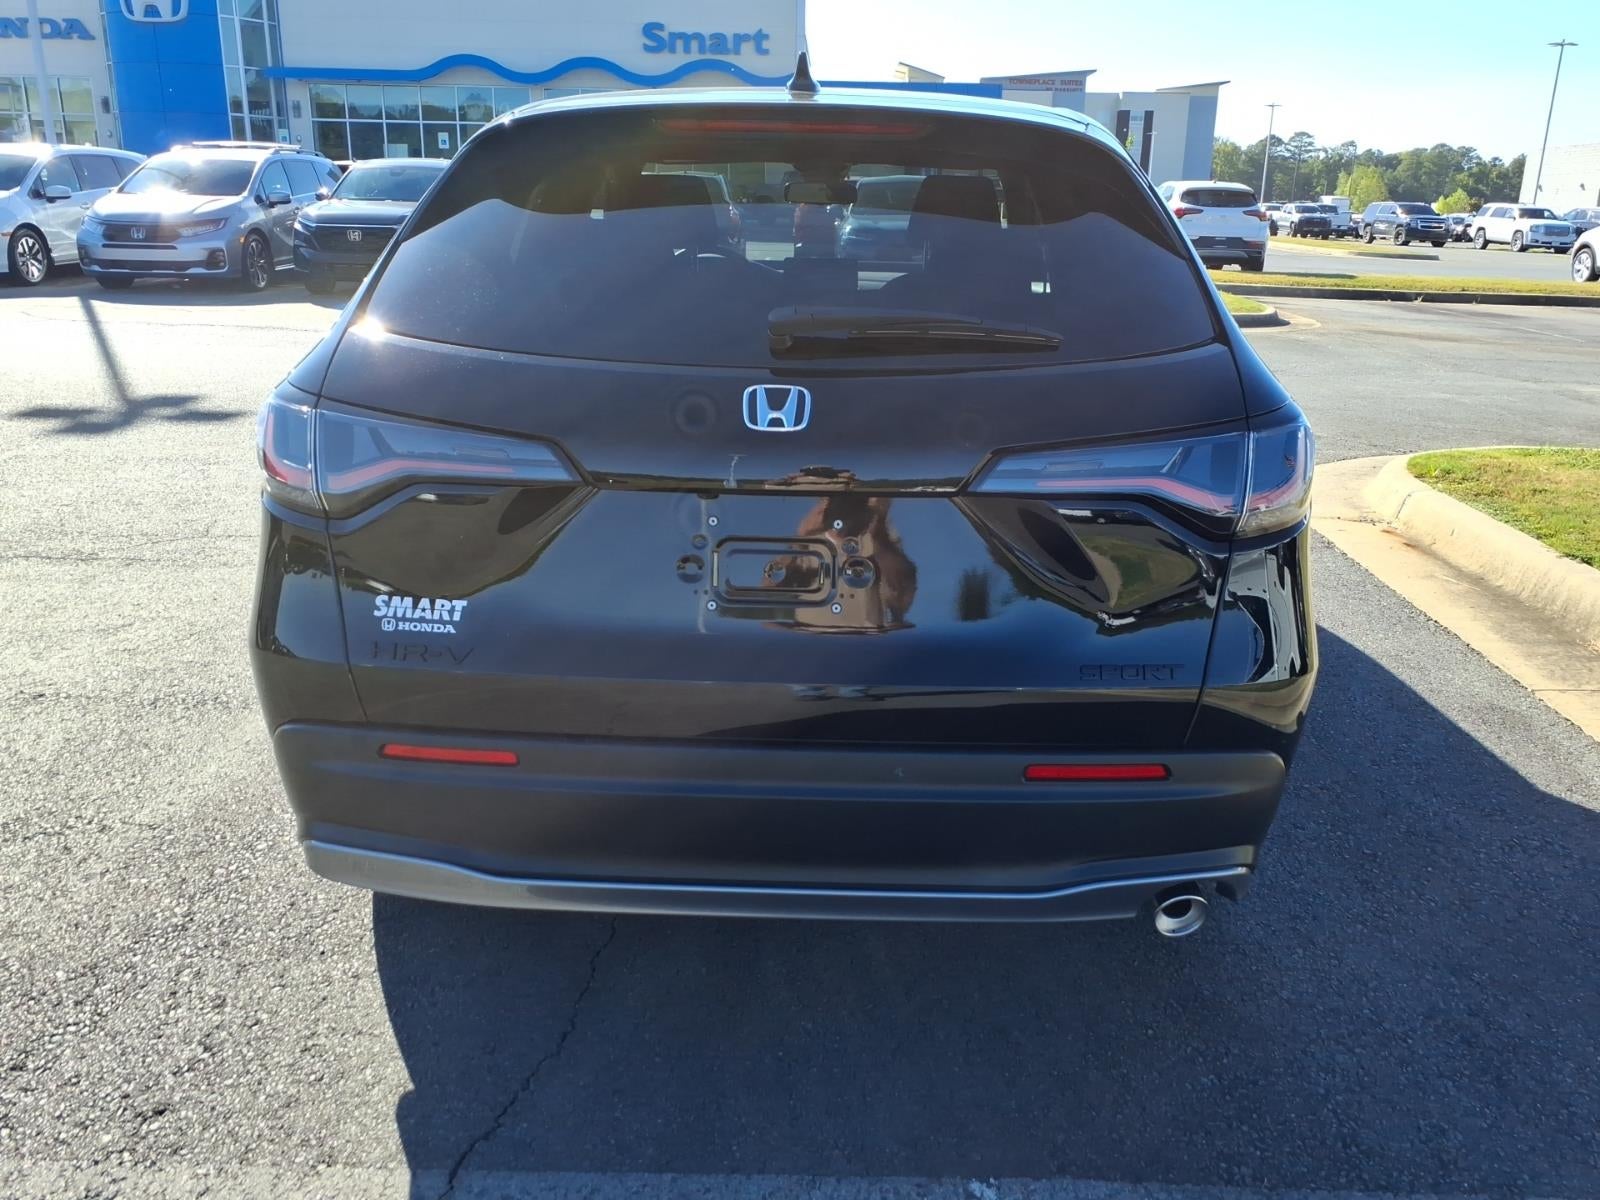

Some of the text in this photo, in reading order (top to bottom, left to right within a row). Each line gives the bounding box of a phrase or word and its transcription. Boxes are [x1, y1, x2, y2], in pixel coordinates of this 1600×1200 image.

[642, 22, 769, 55] Smart
[373, 595, 468, 621] SMART
[398, 622, 456, 634] HONDA
[373, 640, 475, 665] HR-V
[1079, 664, 1184, 680] SPORT
